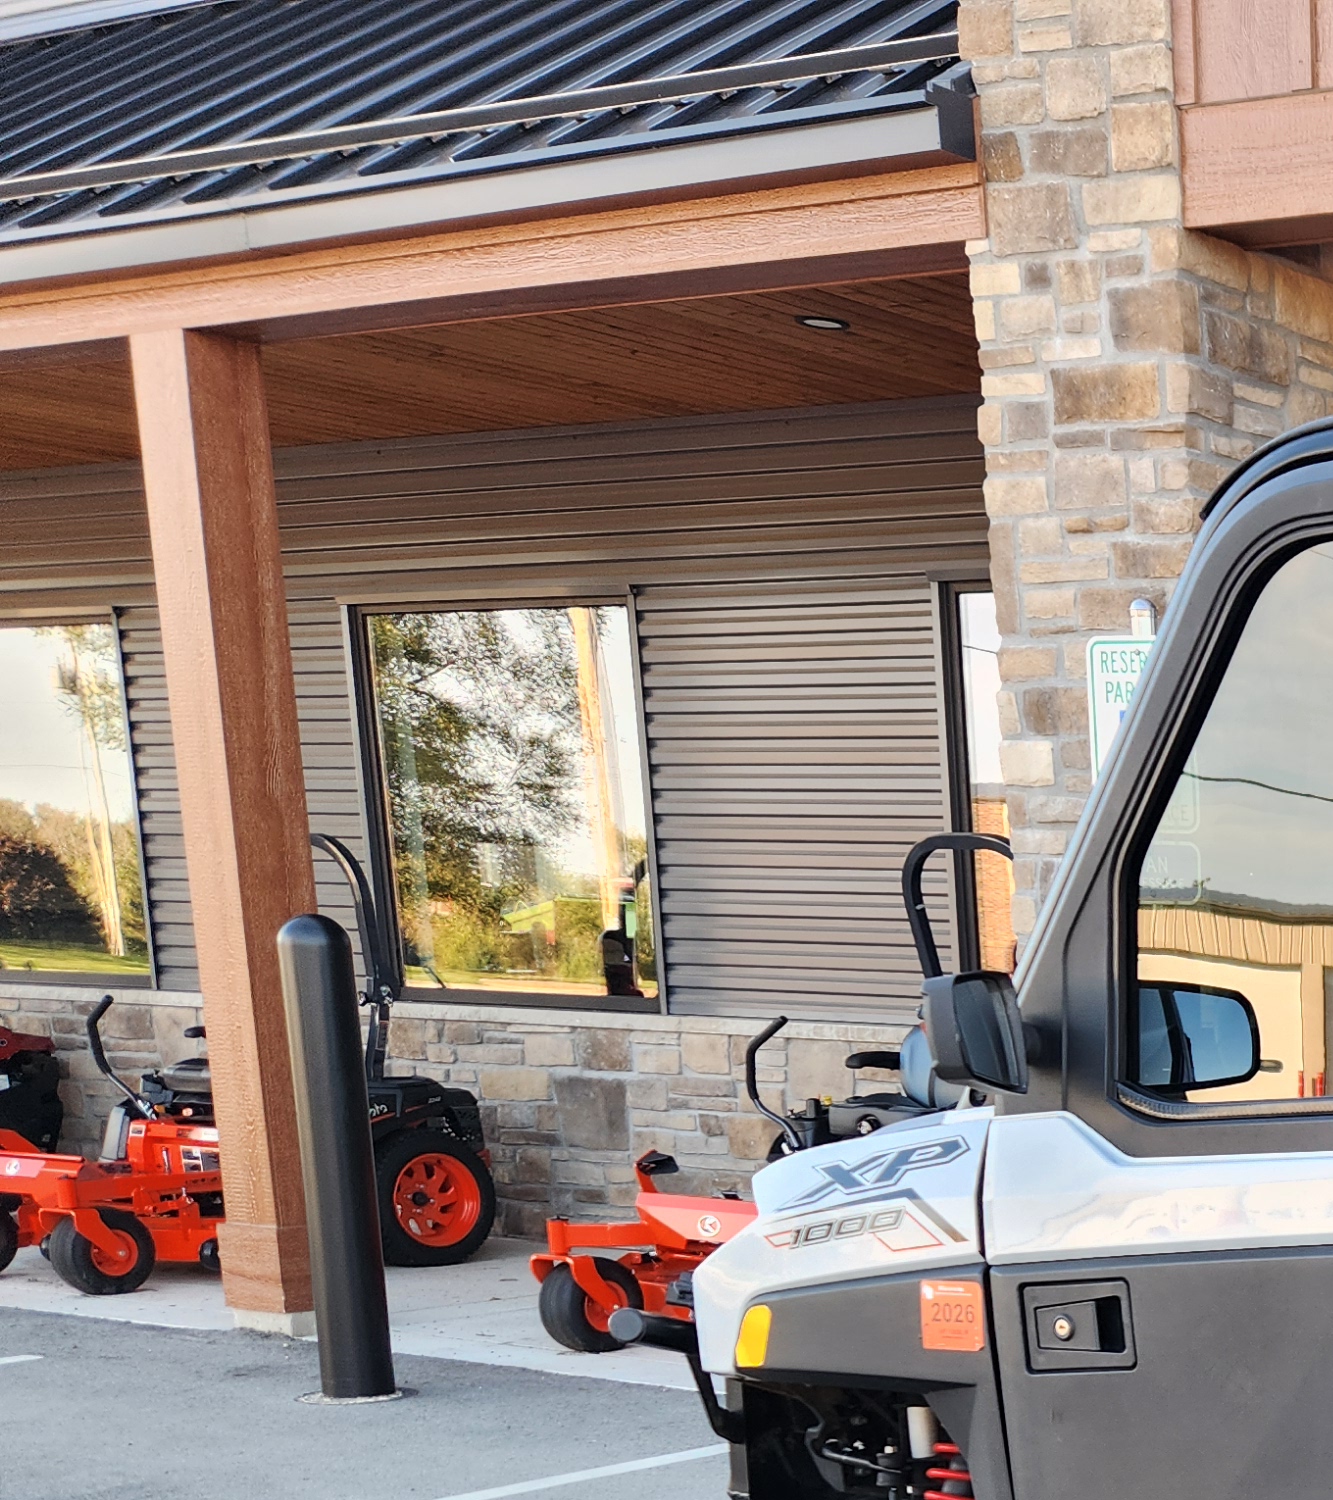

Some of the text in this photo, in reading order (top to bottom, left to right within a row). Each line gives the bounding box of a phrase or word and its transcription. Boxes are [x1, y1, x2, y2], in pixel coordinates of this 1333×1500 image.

[1100, 650, 1148, 674] RESER
[1146, 856, 1169, 874] AN
[774, 1135, 971, 1212] XP
[789, 1205, 906, 1250] 1000
[931, 1302, 975, 1323] 2026
